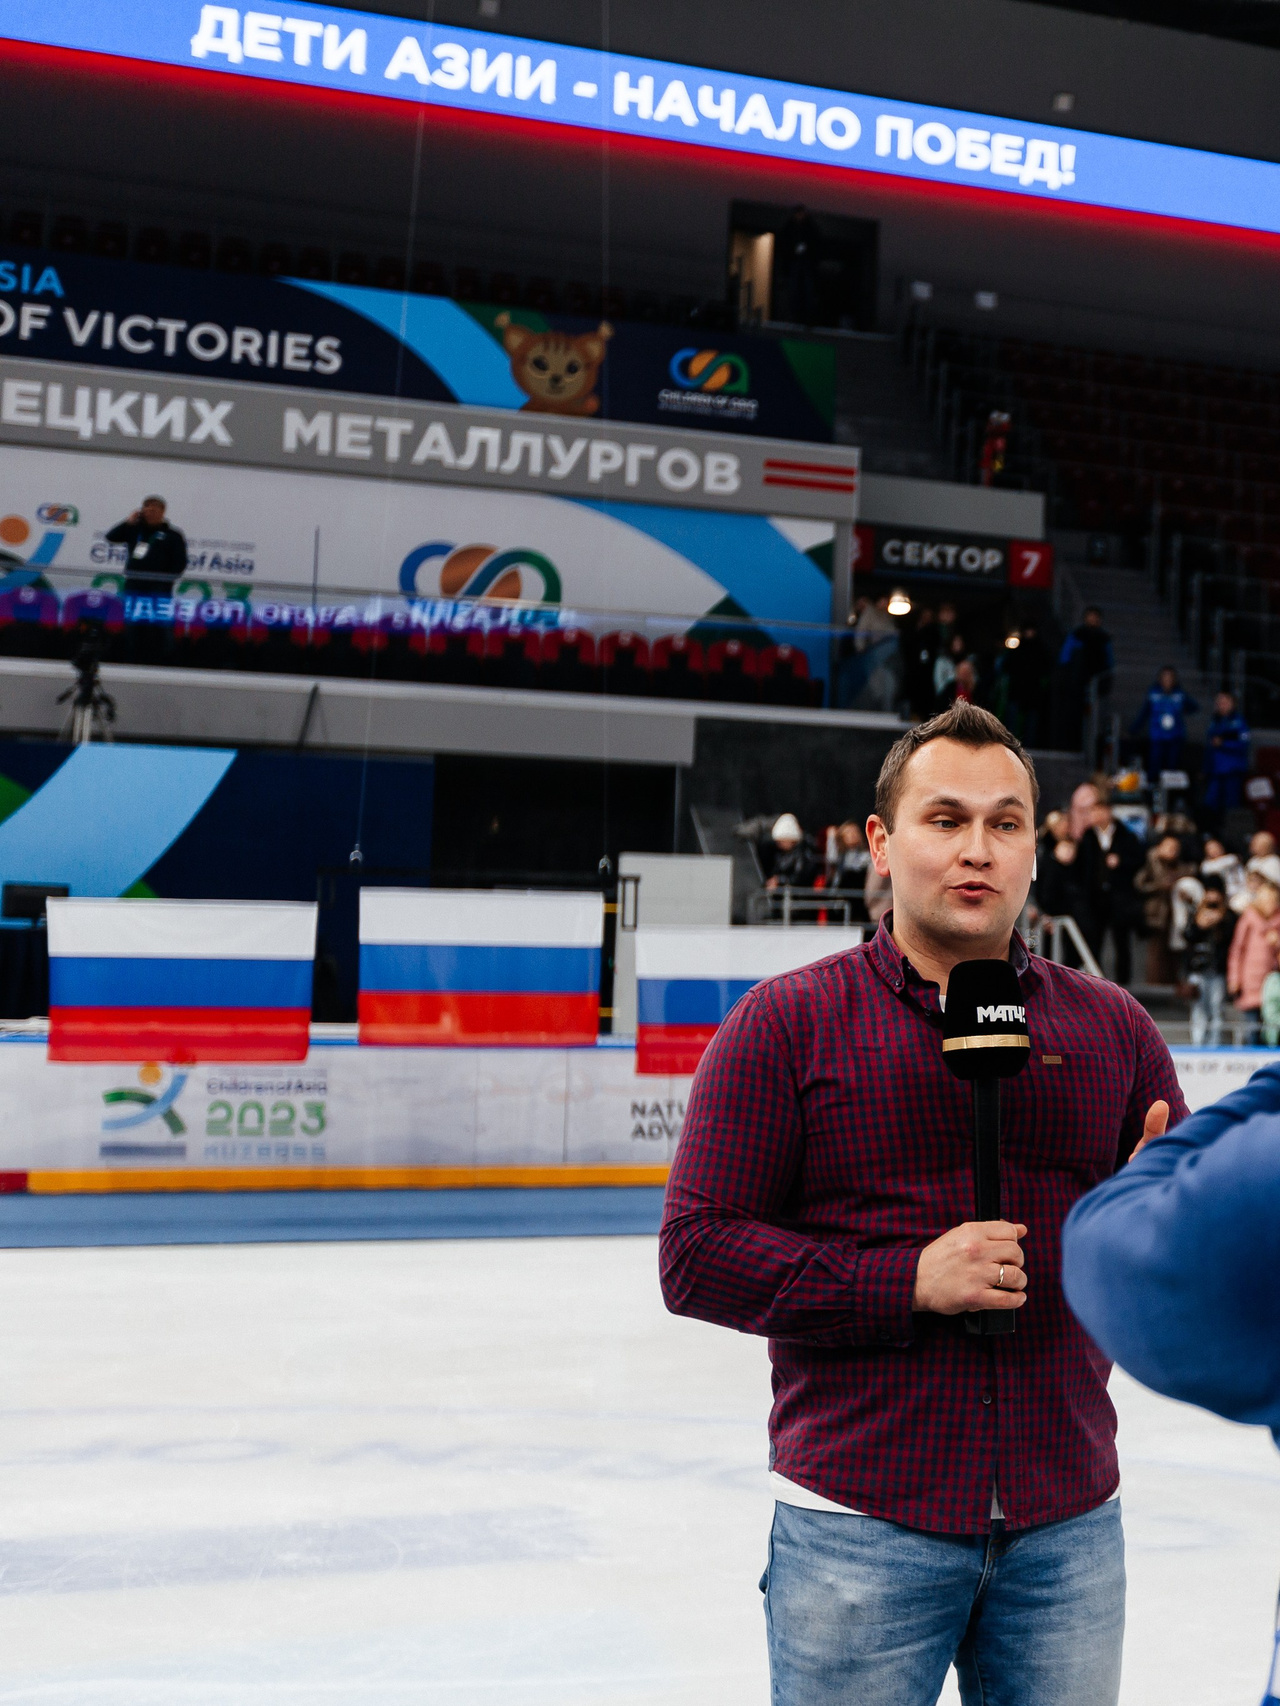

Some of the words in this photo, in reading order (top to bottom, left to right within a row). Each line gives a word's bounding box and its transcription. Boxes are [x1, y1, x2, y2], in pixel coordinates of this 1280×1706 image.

[191, 4, 367, 75] ДЕТИ
[384, 36, 556, 105] АЗИИ
[572, 80, 598, 98] -
[613, 71, 862, 151] НАЧАЛО
[875, 114, 1077, 190] ПОБЕД!
[62, 306, 343, 375] VICTORIES
[0, 378, 235, 447] ЕЦКИХ
[282, 407, 743, 495] МЕТАЛЛУРГОВ
[882, 539, 1003, 573] СЕКТОР
[1019, 550, 1042, 579] 7
[204, 1098, 328, 1137] 2023
